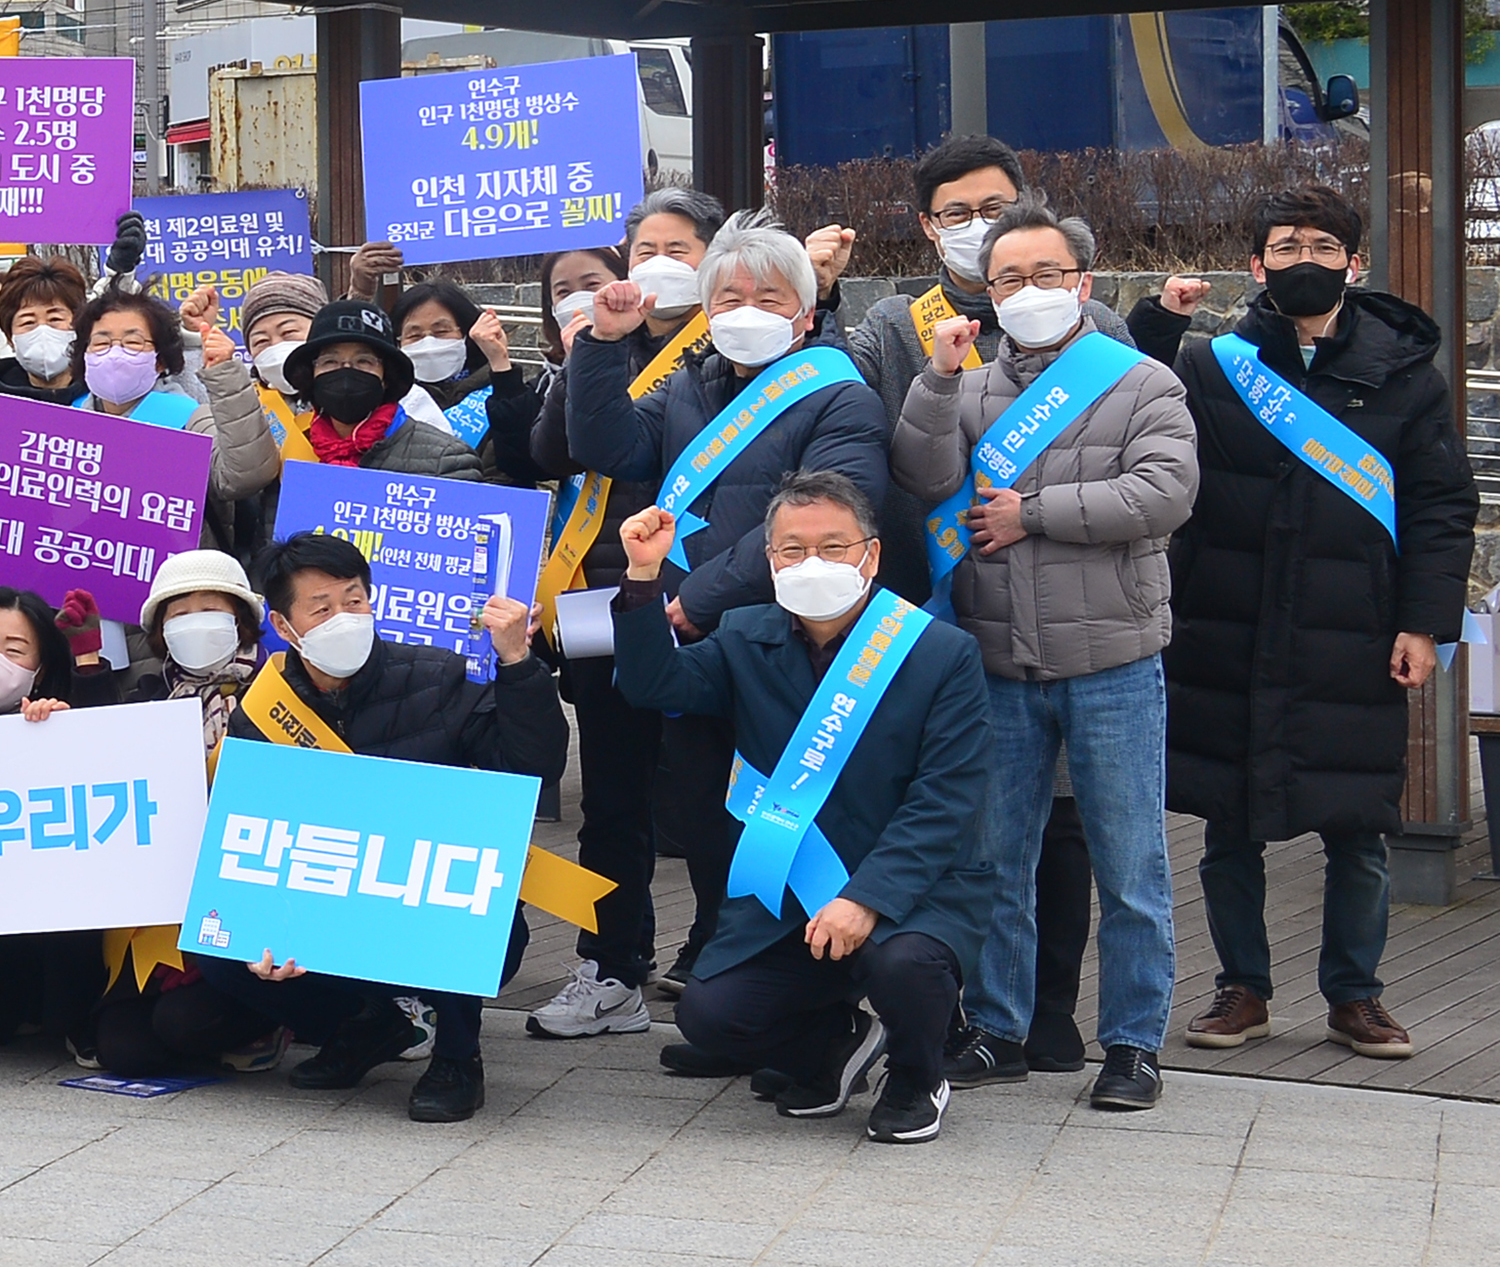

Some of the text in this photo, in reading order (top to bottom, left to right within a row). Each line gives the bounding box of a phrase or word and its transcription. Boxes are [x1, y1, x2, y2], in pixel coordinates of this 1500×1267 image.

[14, 86, 105, 119] 1천명당
[468, 76, 522, 99] 연수구
[418, 94, 580, 125] 인구 1천명당 병상수
[13, 118, 77, 149] 2.5명
[460, 120, 539, 152] 4.9개!
[9, 152, 61, 182] 도시
[70, 152, 96, 183] 중
[411, 161, 594, 209] 인천 지자체 중
[167, 211, 285, 238] 제2의료원 및
[387, 193, 623, 243] 옹진군 다음으로 꼴찌!
[170, 237, 250, 264] 공공의대
[255, 235, 304, 259] 유치!
[919, 297, 943, 312] 지역
[921, 305, 946, 326] 보건
[1235, 359, 1256, 389] 인구
[1247, 372, 1273, 406] 39만
[1002, 385, 1070, 454] 연수구민
[1258, 386, 1294, 425] 연수구
[19, 430, 104, 472] 감염병
[978, 441, 1018, 481] 천명당
[139, 489, 197, 532] 요람
[386, 483, 436, 509] 연수구
[334, 501, 433, 536] 인구 1천명당
[33, 526, 155, 583] 공공의대
[380, 547, 442, 572] (인천 전체
[220, 813, 504, 917] 만듭니다
